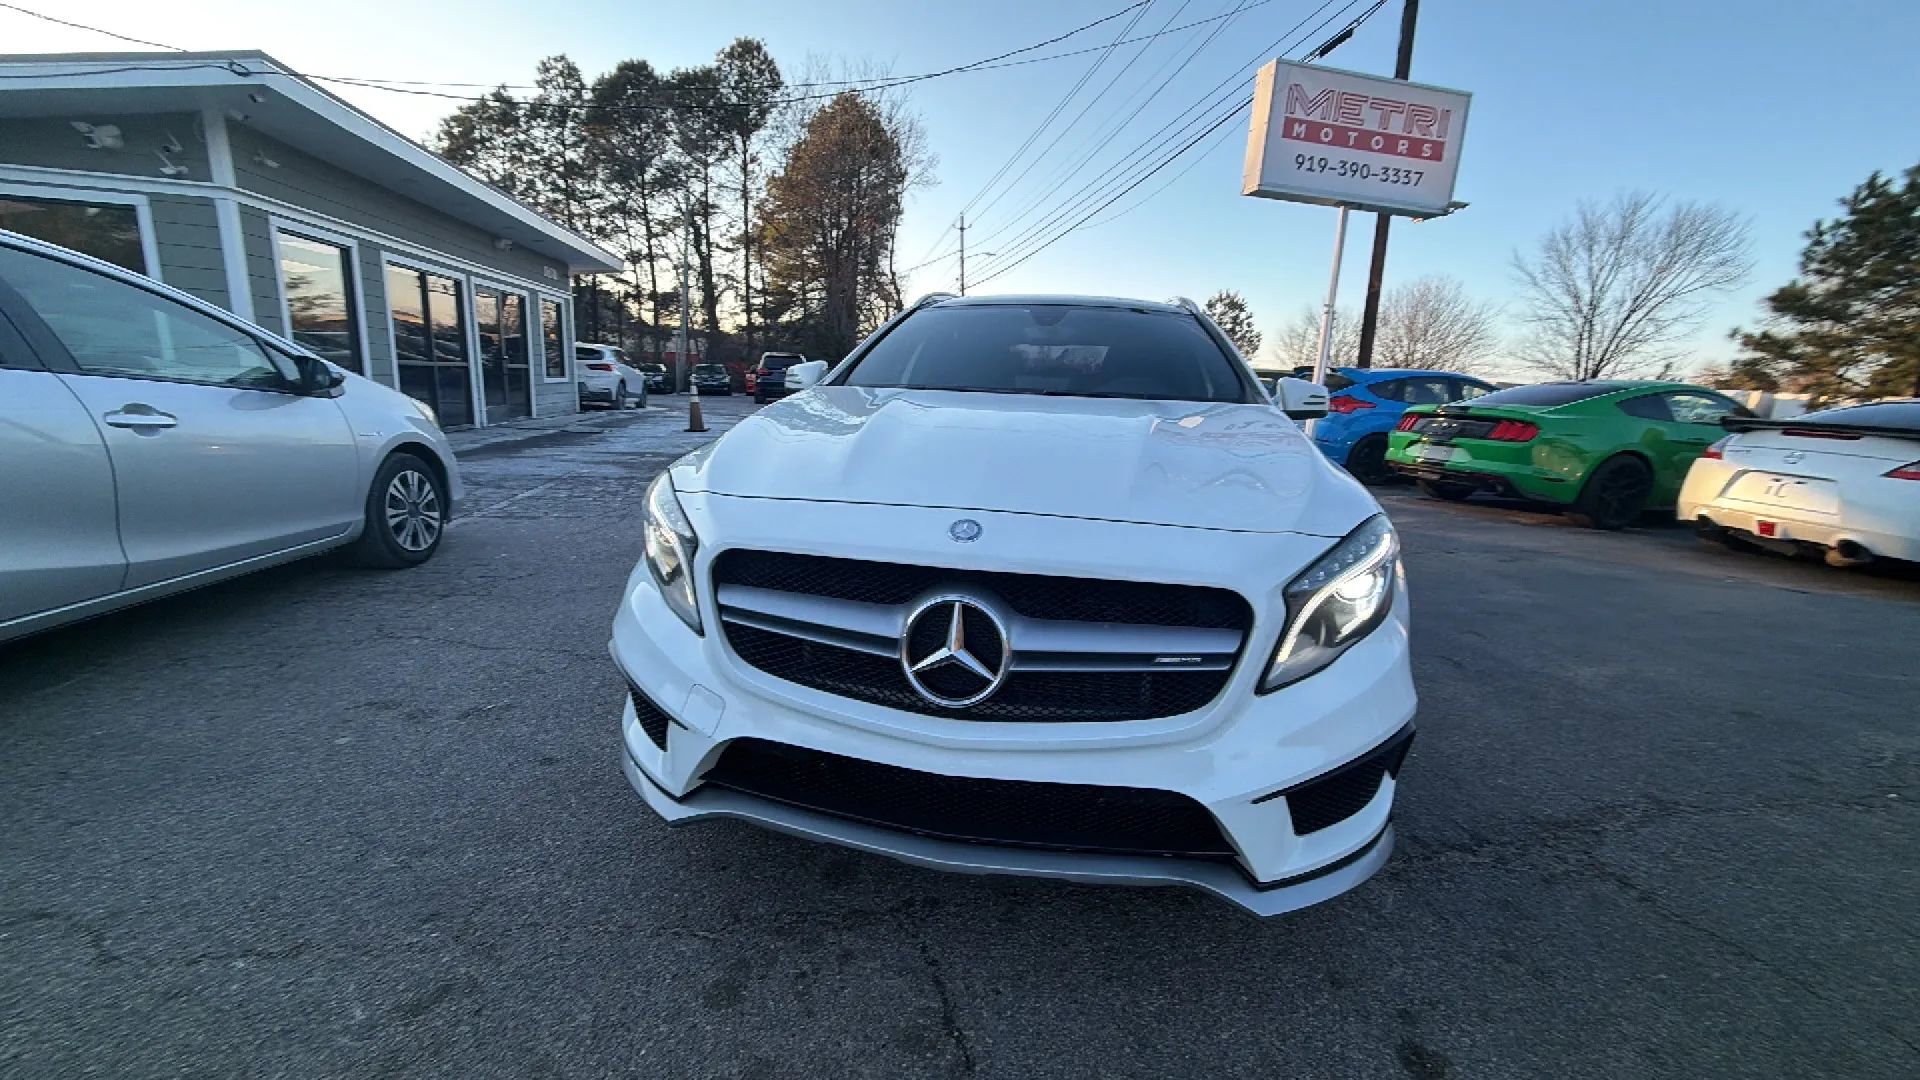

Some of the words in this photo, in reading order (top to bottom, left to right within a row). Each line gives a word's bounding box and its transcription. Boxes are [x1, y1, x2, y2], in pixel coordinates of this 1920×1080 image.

[1285, 83, 1452, 139] METRI
[1291, 121, 1433, 158] MOTORS
[1295, 153, 1425, 187] 919-390-3337
